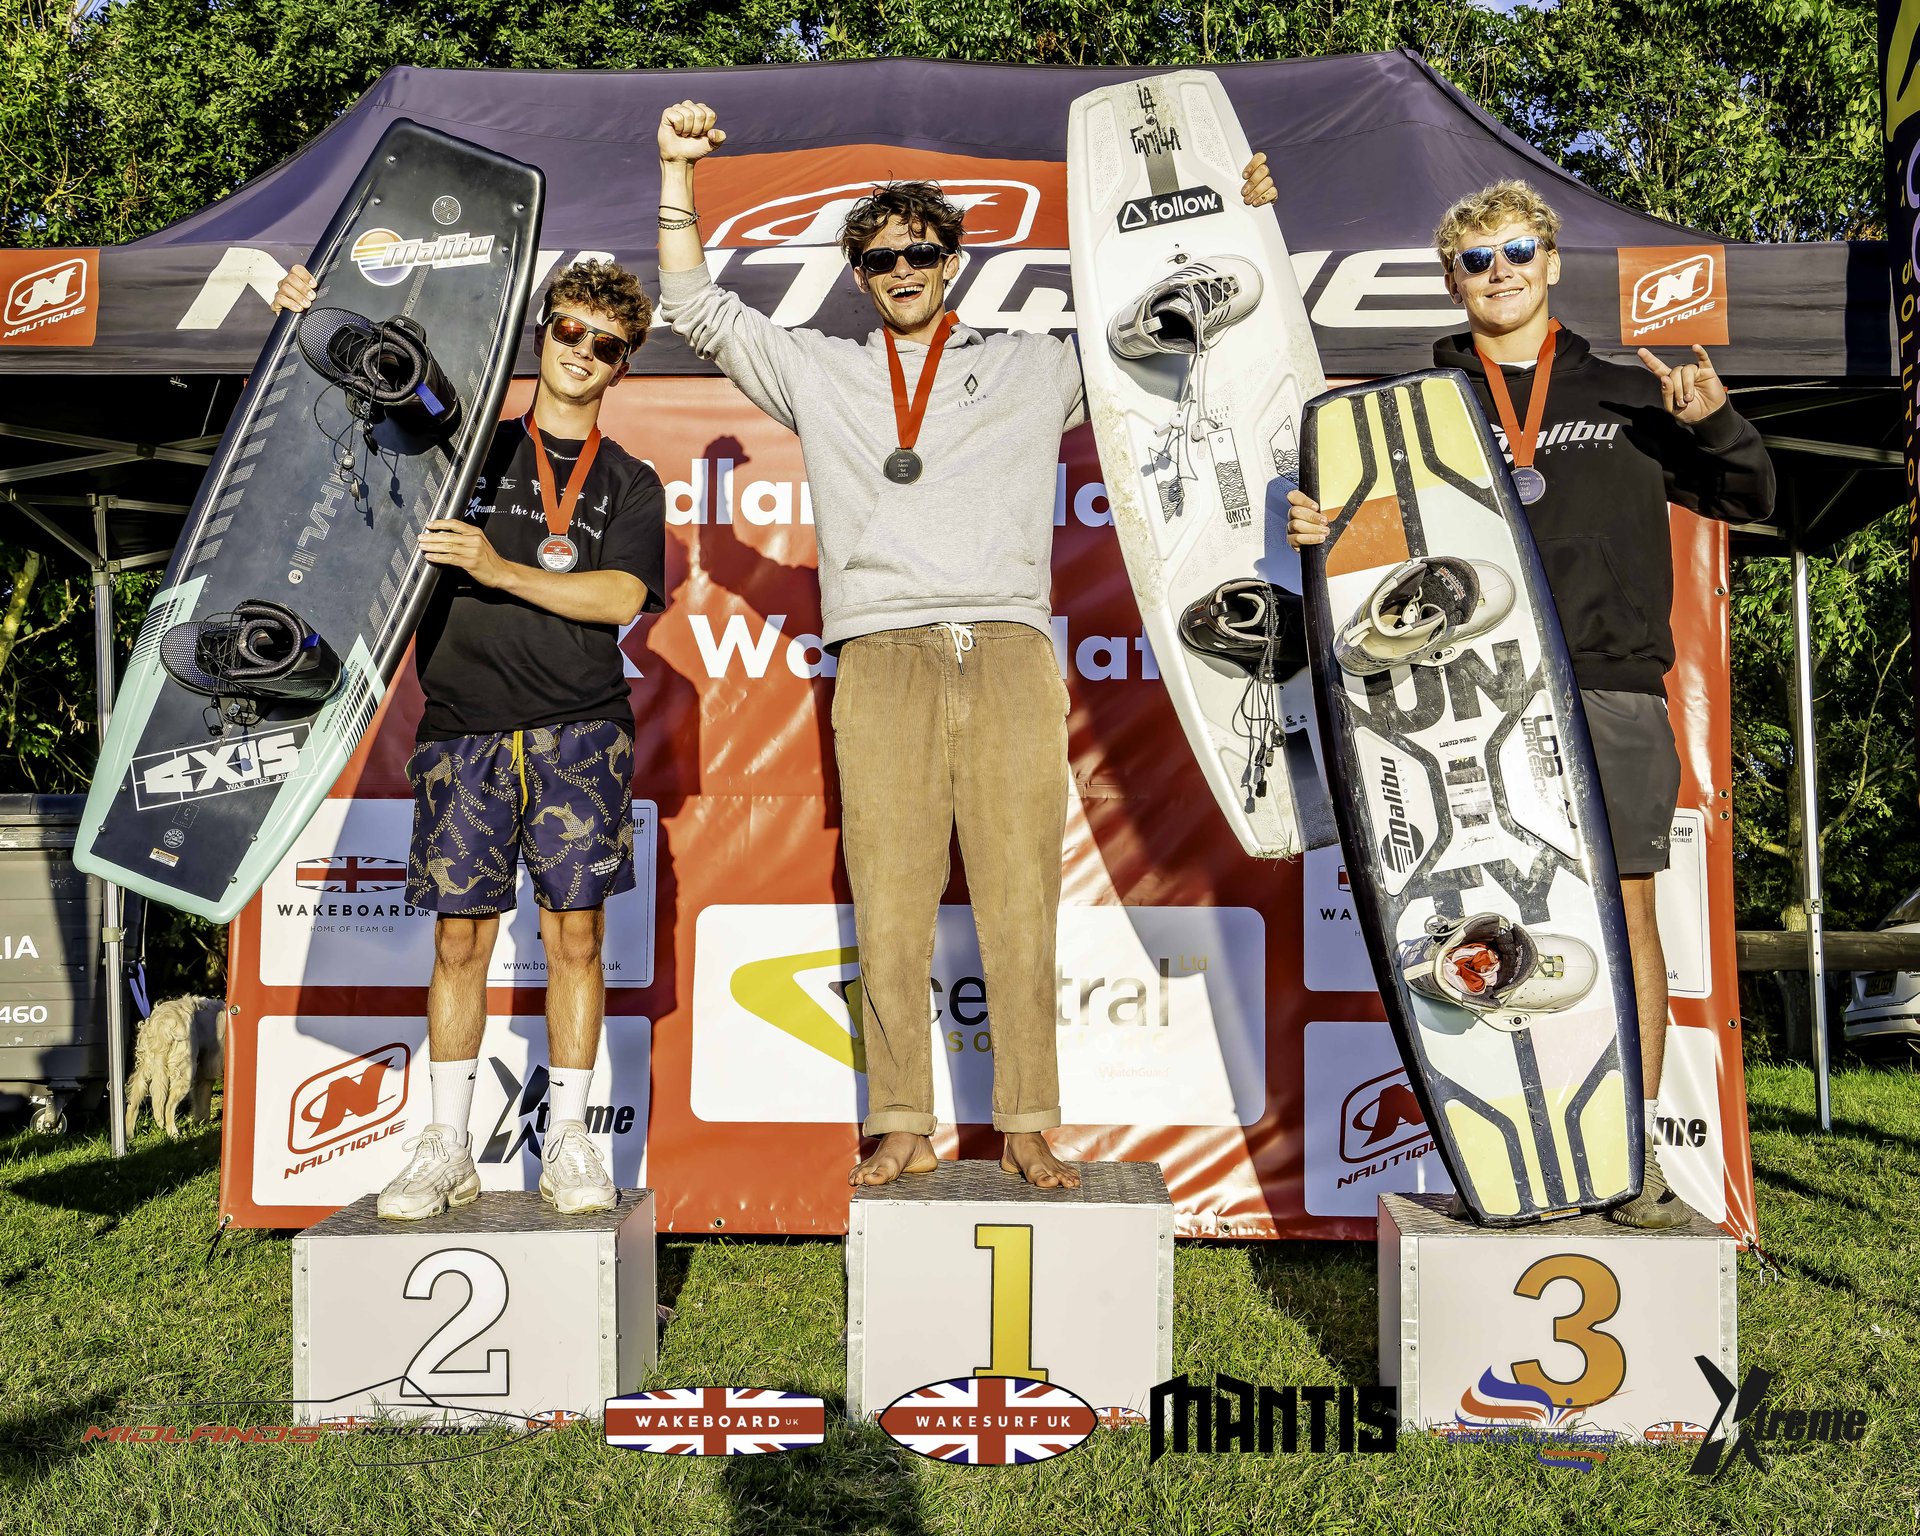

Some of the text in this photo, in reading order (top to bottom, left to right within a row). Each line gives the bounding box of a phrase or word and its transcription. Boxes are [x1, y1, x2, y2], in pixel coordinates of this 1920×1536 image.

[1150, 193, 1219, 221] follow.
[382, 236, 493, 266] Malibu
[3, 305, 87, 338] NAUTIQUE
[1632, 300, 1716, 337] NAUTIQUE
[1545, 442, 1614, 455] BOATS
[511, 504, 529, 516] the
[577, 517, 602, 540] brand
[1225, 507, 1252, 524] UNITY
[1439, 739, 1459, 748] LIQUID
[277, 904, 431, 917] WAKEBOARD UK
[1179, 954, 1209, 971] Ltd
[284, 1119, 407, 1180] NAUTIQUE
[972, 1223, 1050, 1383] 1
[400, 1247, 510, 1398] 2
[1510, 1253, 1627, 1408] 3
